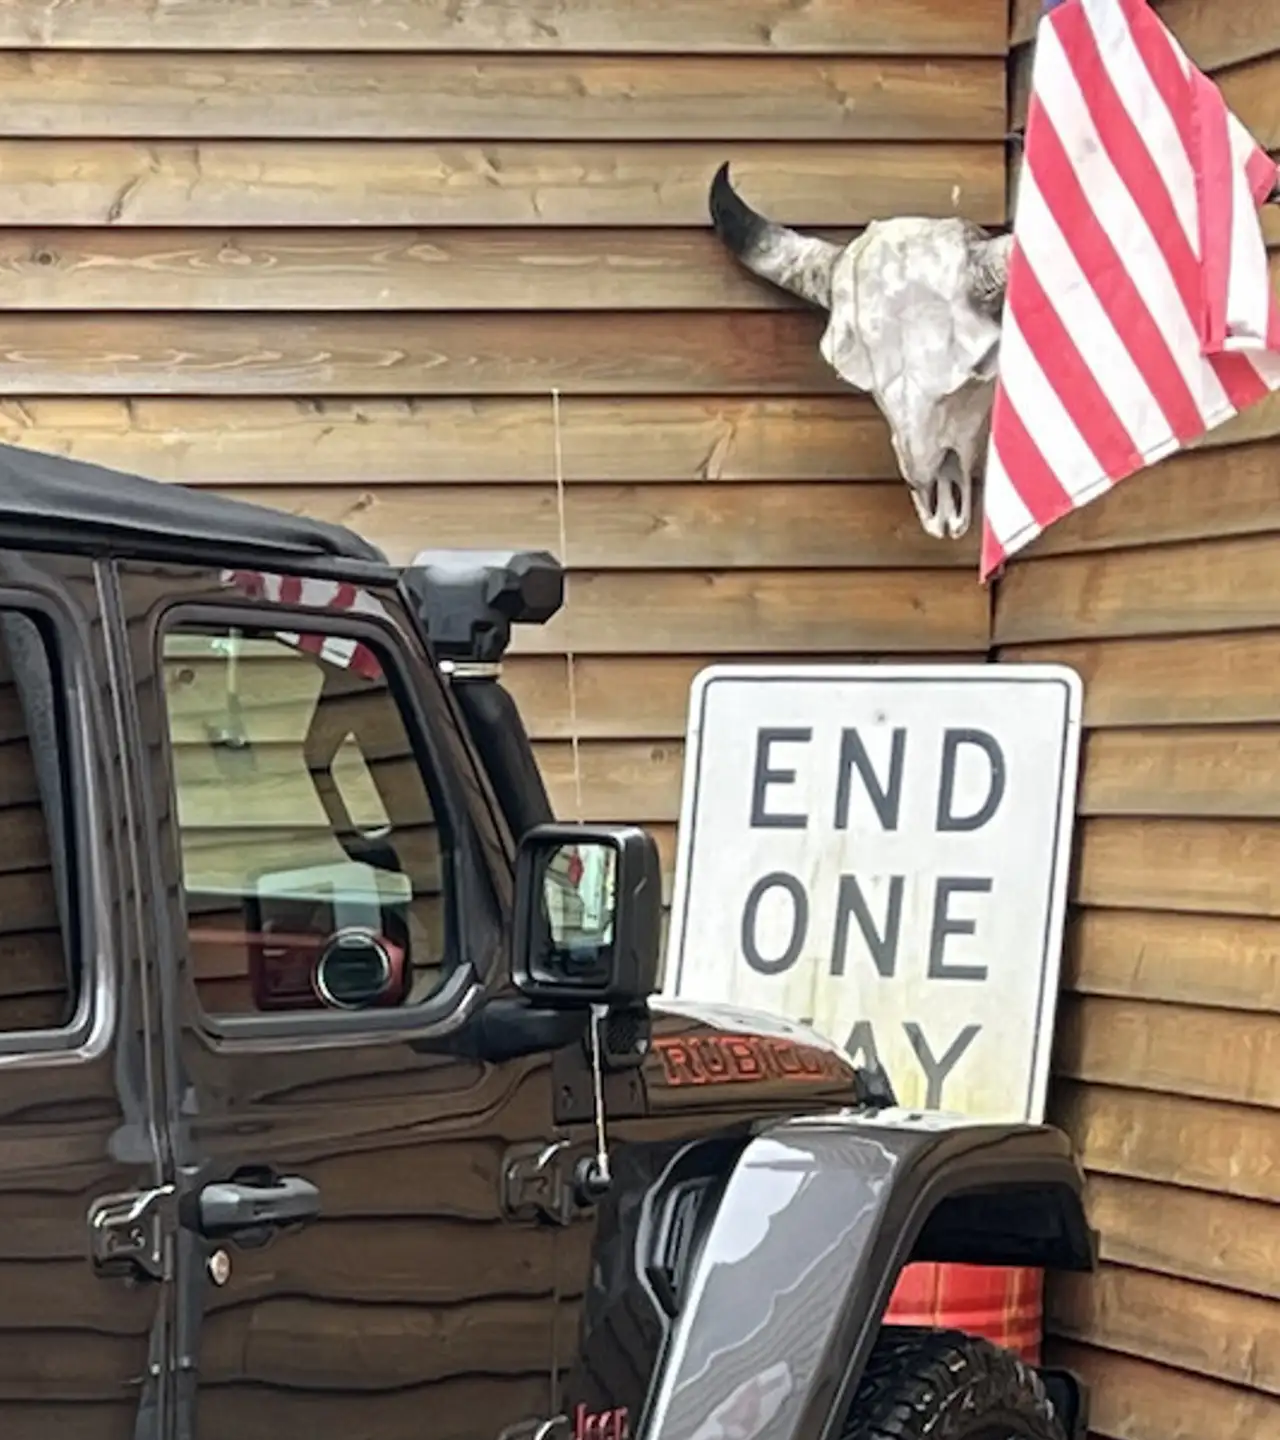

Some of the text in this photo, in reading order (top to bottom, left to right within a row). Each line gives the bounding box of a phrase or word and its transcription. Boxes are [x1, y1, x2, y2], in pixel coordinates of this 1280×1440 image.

[749, 727, 1007, 832] END
[740, 871, 993, 981] ONE
[825, 1020, 983, 1110] AY
